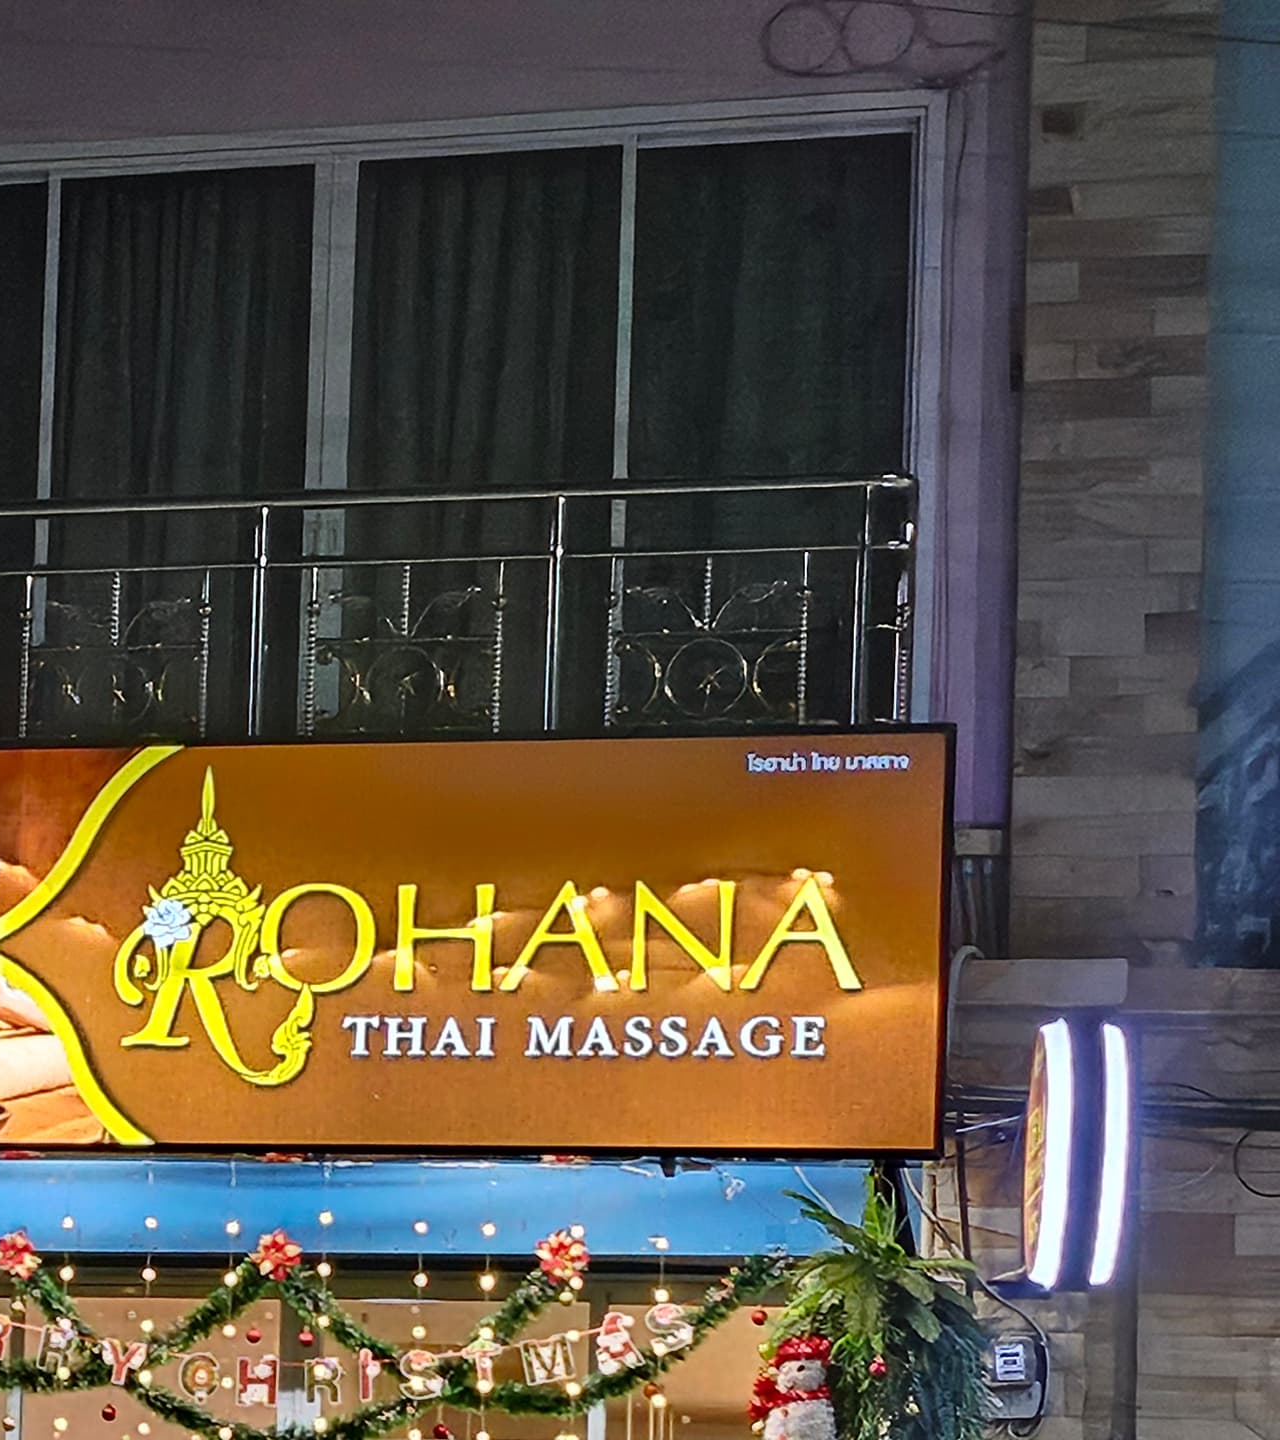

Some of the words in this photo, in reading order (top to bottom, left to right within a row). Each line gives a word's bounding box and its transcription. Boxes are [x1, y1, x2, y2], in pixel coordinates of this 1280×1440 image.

[811, 752, 840, 771] ไทย
[113, 877, 863, 1087] ROHANA
[342, 1015, 497, 1058] THAI
[525, 1015, 827, 1059] MASSAGE
